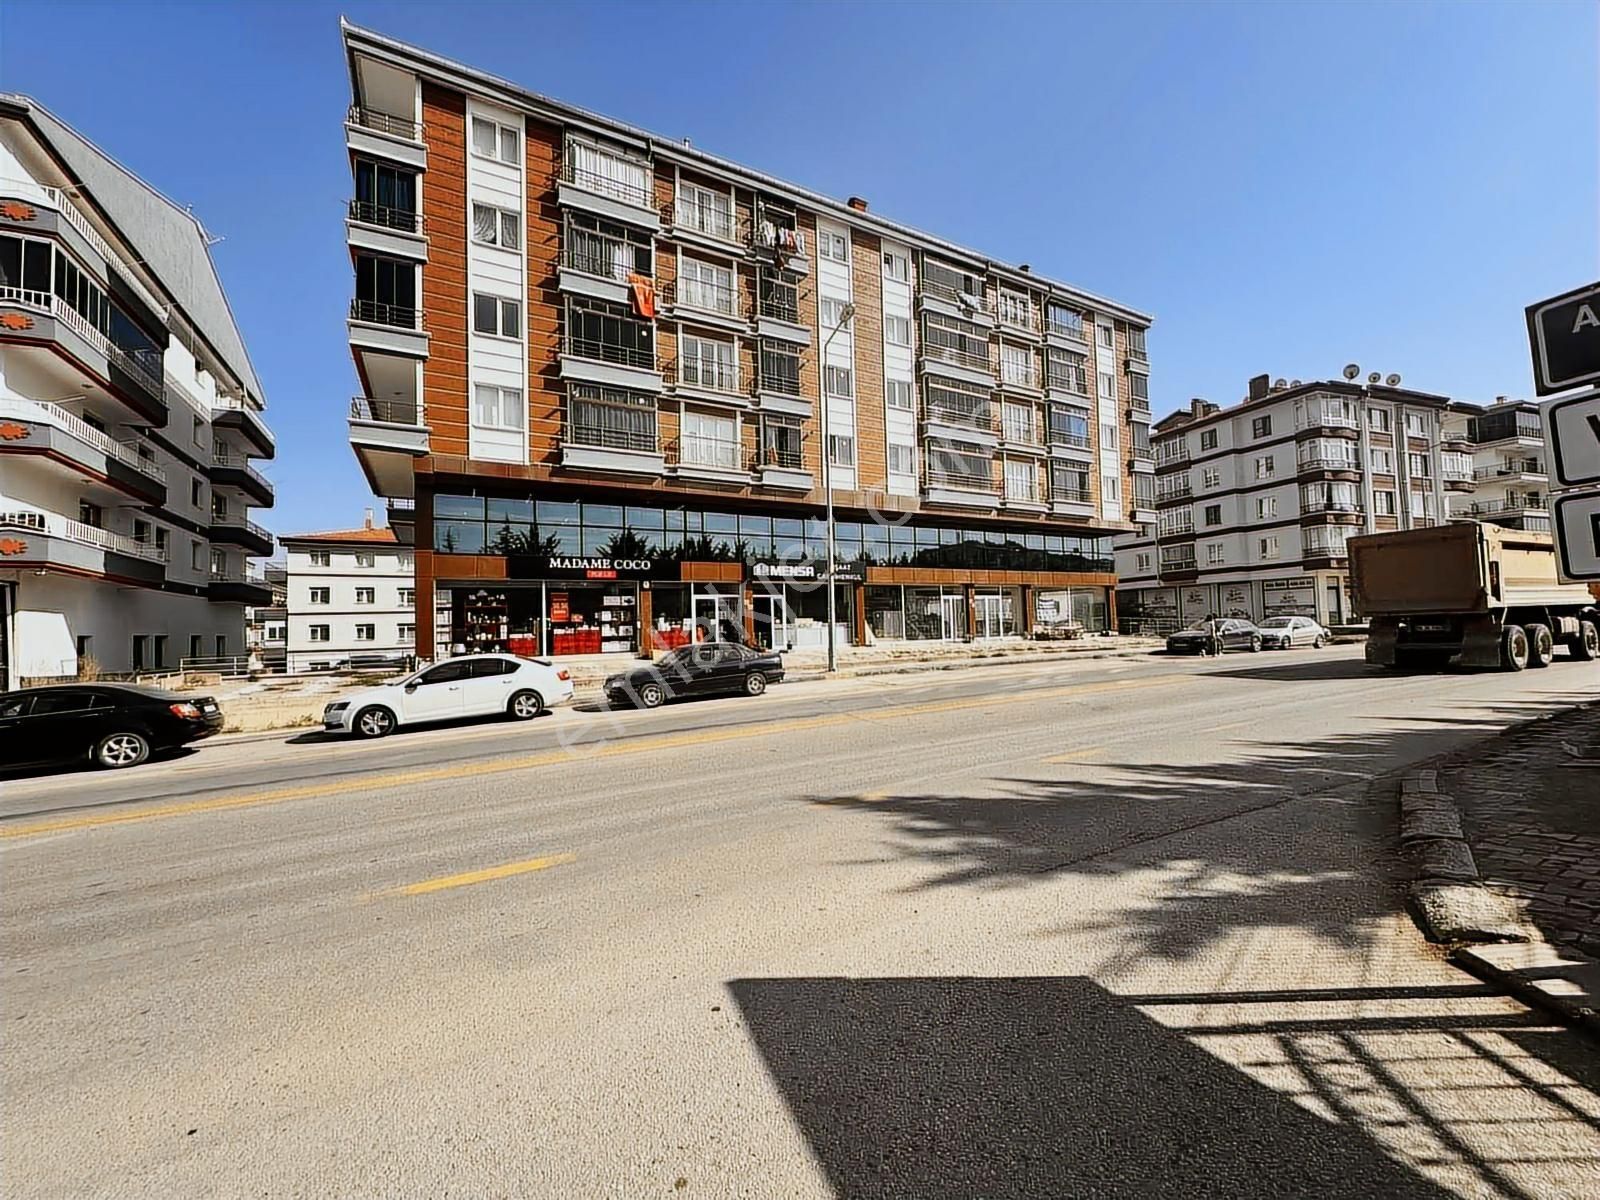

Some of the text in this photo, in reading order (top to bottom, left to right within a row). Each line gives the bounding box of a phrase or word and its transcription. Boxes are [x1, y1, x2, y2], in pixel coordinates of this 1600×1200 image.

[549, 557, 651, 570] MADAME COCO
[770, 565, 815, 577] MENSA
